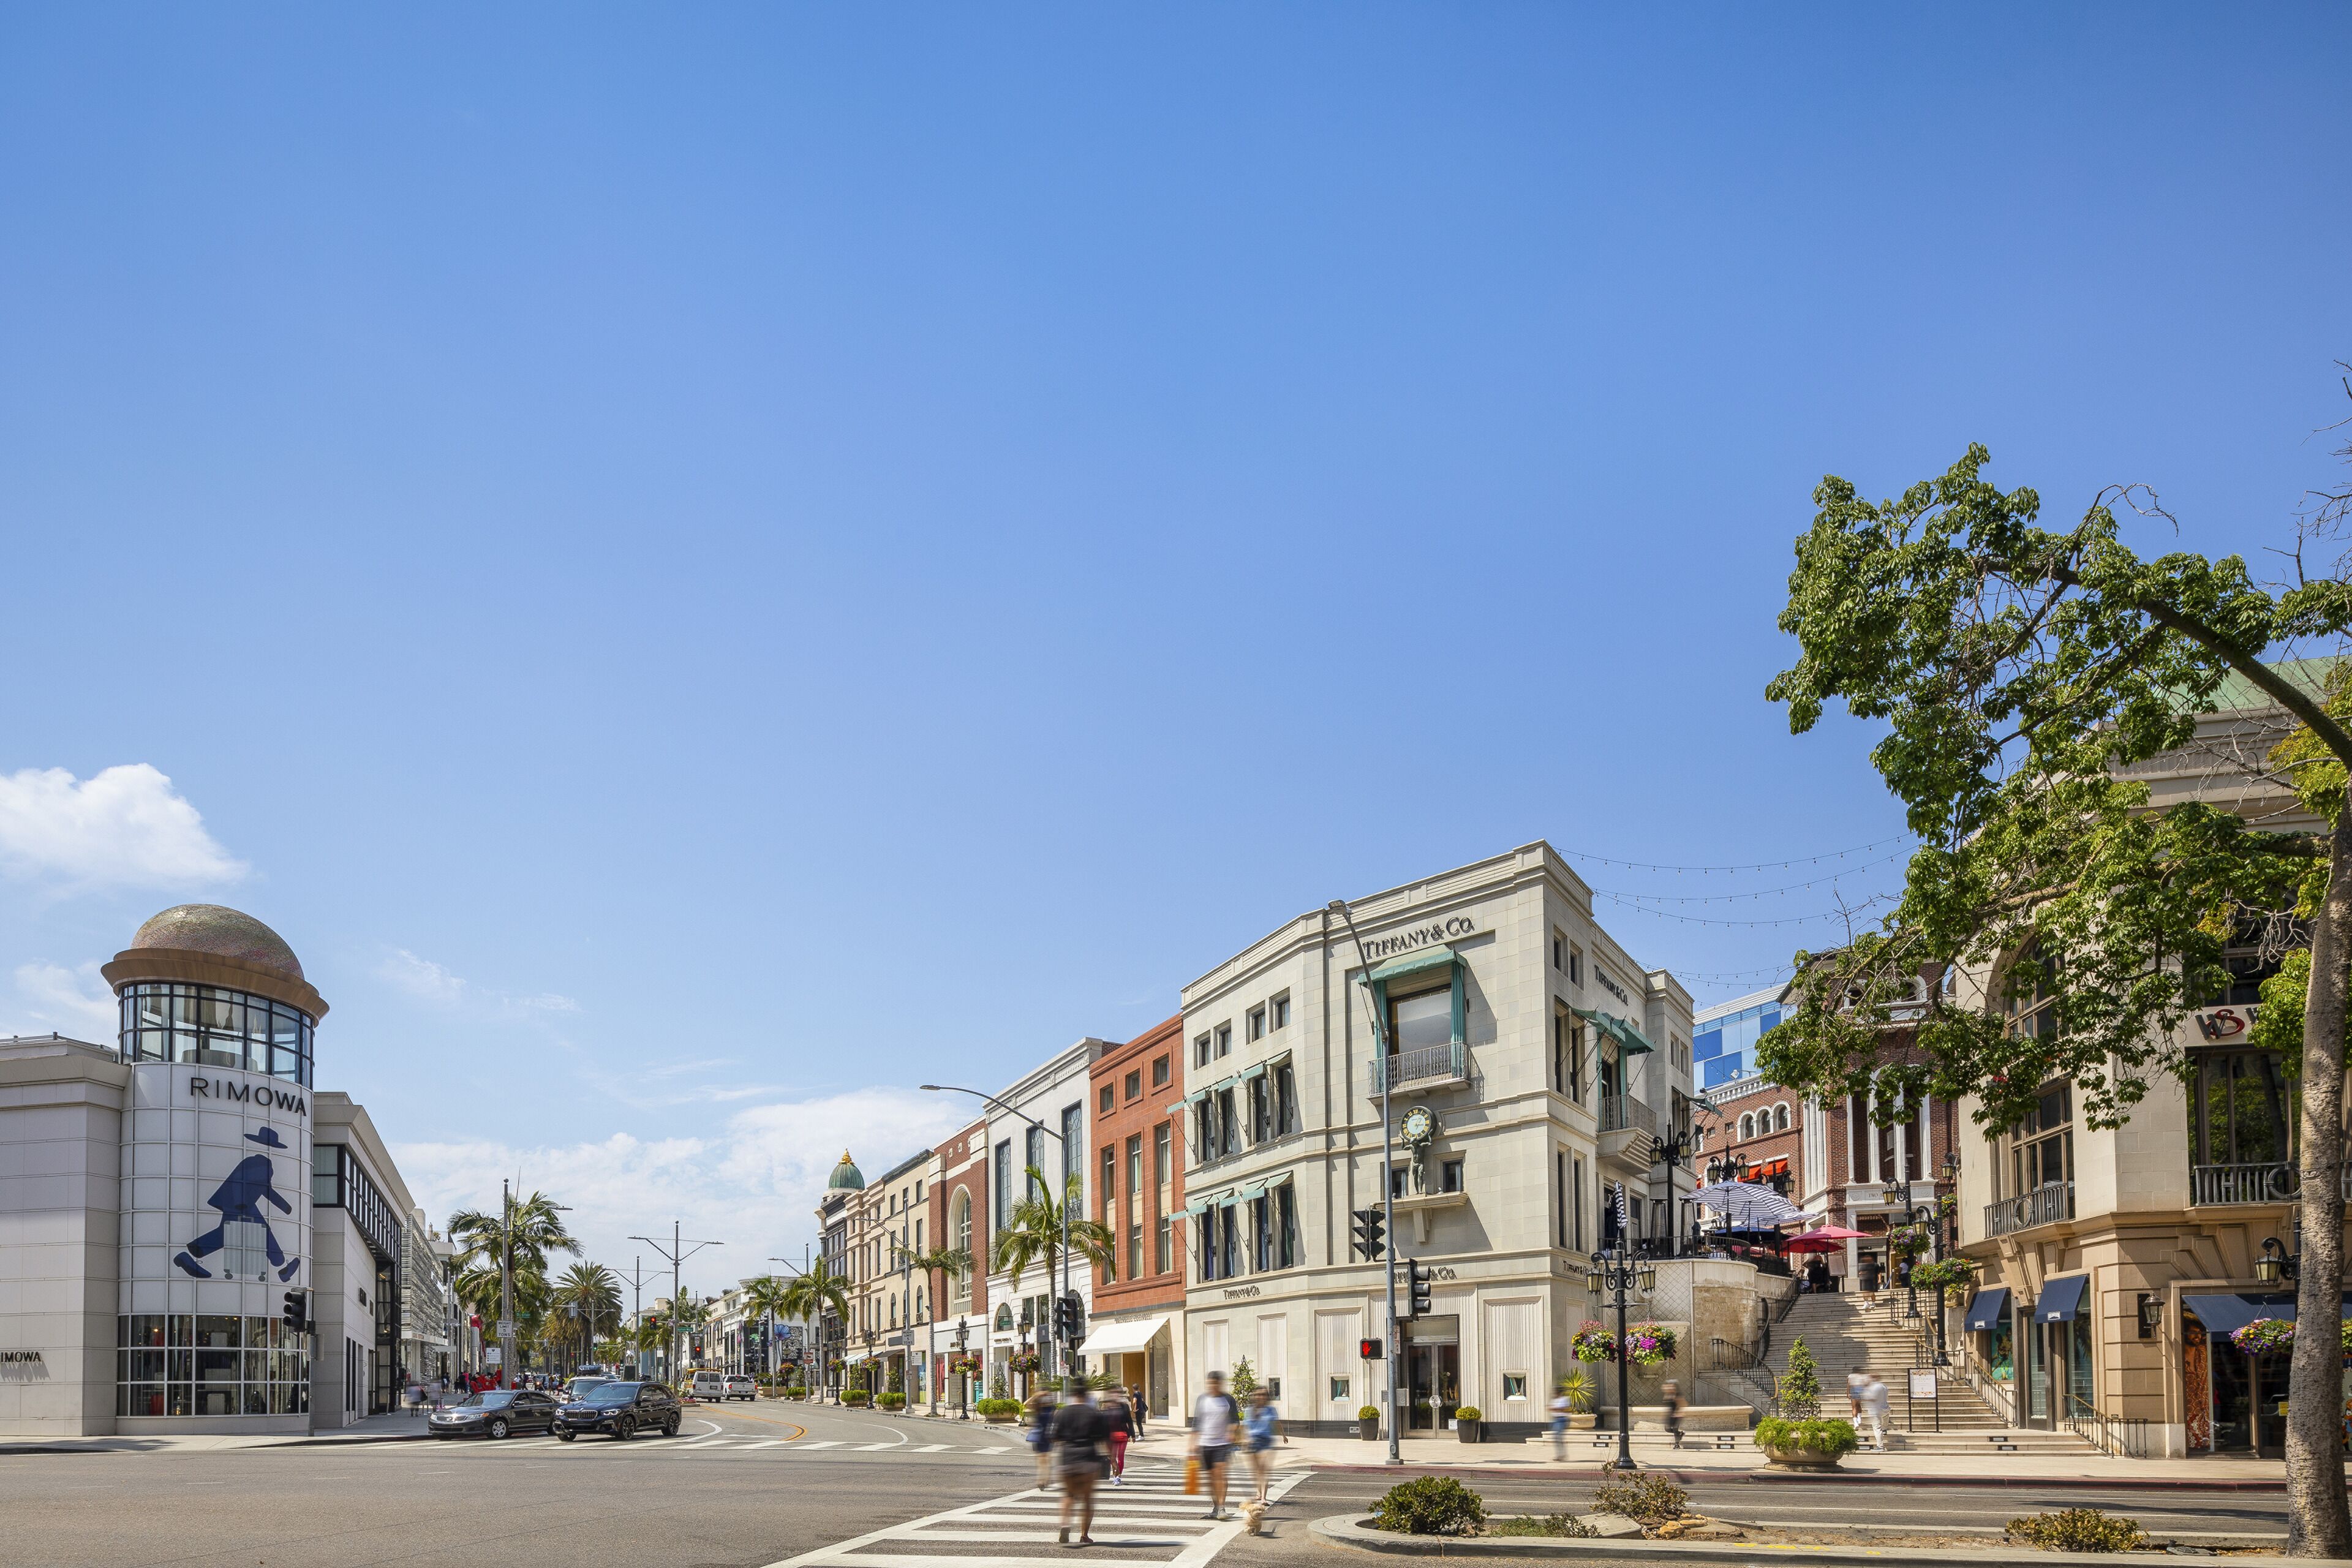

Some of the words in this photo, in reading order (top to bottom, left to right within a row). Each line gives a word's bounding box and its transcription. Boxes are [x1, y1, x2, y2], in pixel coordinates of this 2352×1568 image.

[1362, 927, 1431, 960] TIFFANY
[1594, 965, 1616, 995] TIFFANY
[190, 1077, 307, 1117] RIMOWA
[0, 1351, 42, 1363] IMOWA
